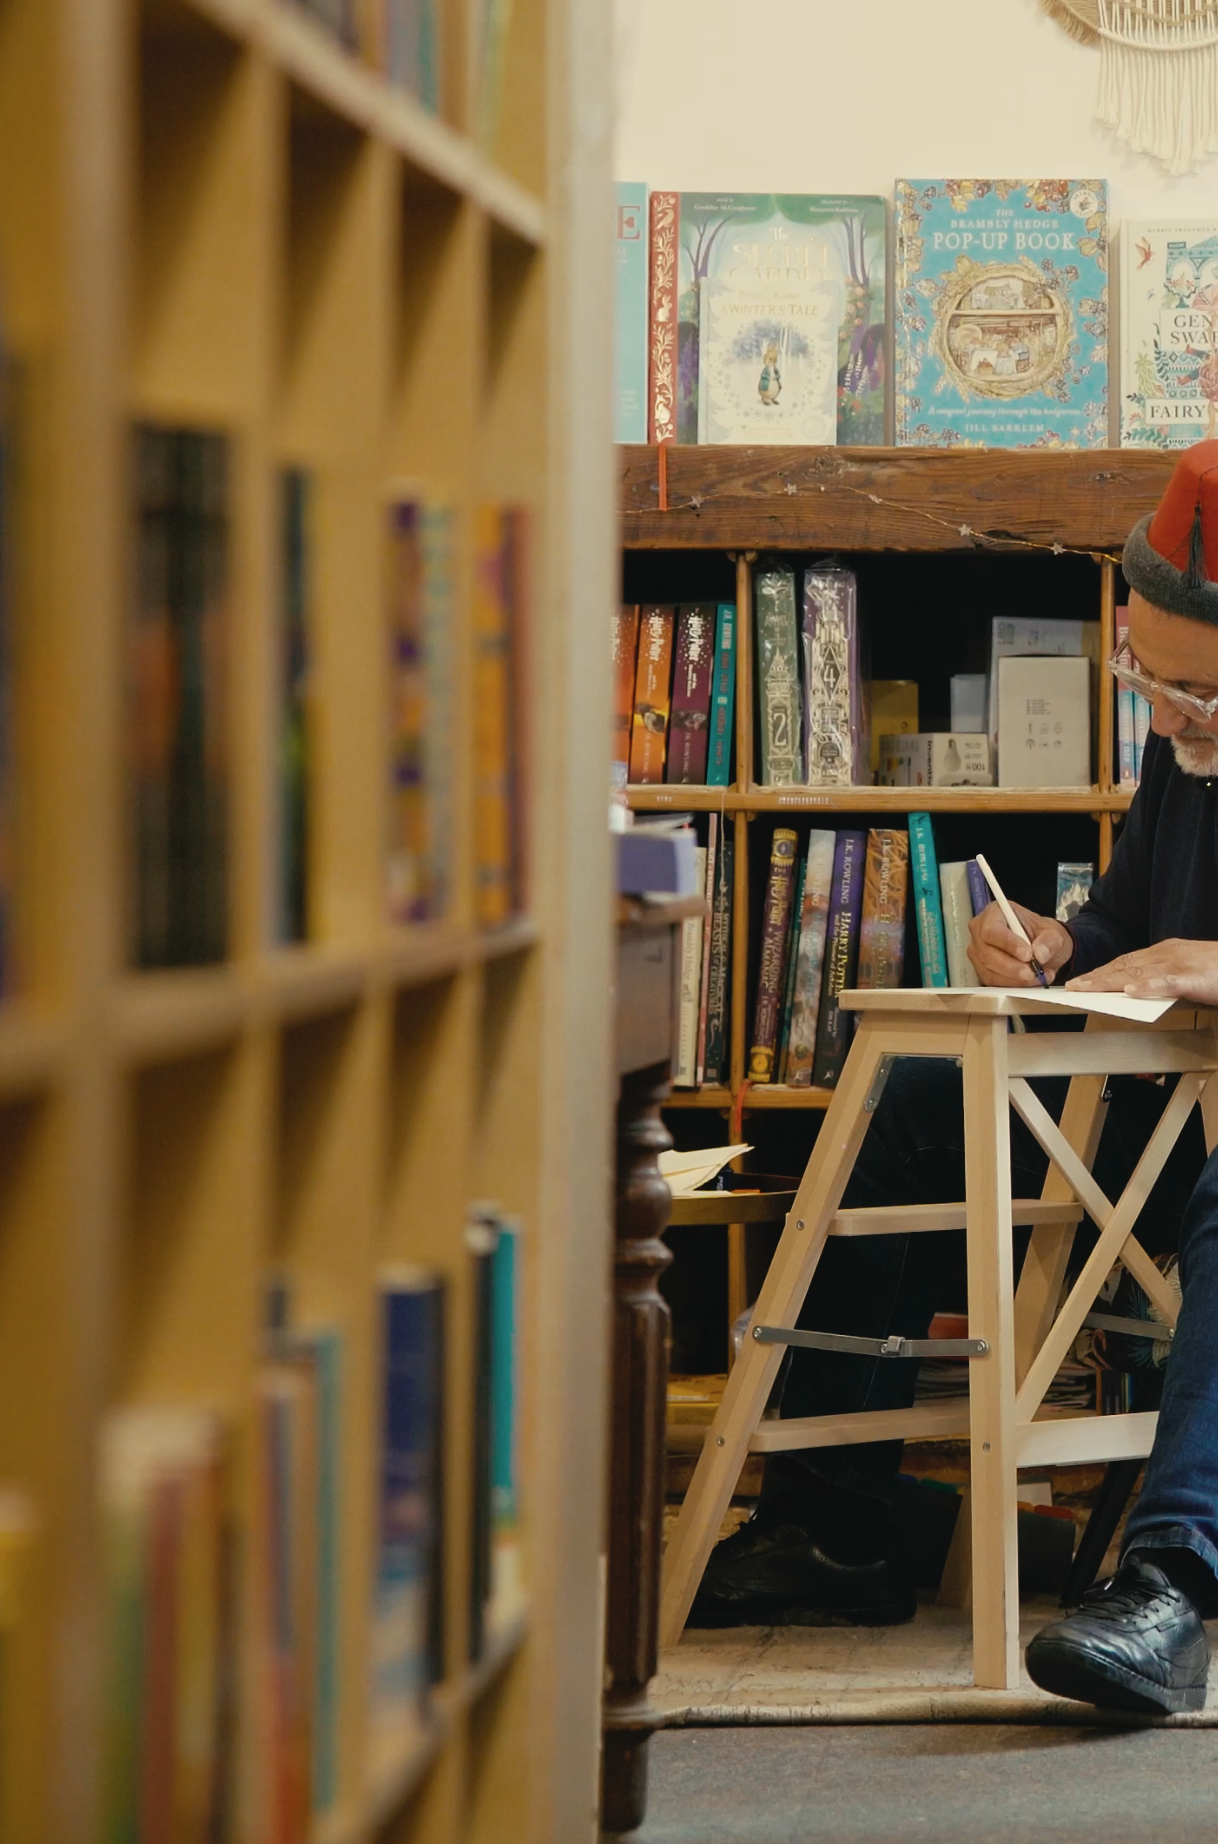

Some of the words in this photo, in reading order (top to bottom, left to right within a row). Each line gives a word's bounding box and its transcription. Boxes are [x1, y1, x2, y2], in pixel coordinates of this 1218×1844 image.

[933, 232, 1008, 250] POP-UP
[1015, 232, 1076, 250] BOOK
[951, 219, 1010, 229] BRAMBLY
[1014, 219, 1059, 229] HEDGE
[1150, 405, 1206, 418] FAIRY
[823, 665, 836, 688] 4
[773, 712, 787, 746] 2
[844, 838, 854, 855] J.K.
[840, 856, 852, 904] ROWLING
[879, 857, 890, 904] ROWLING
[712, 912, 722, 954] BEASTS
[838, 912, 852, 952] HARRY
[760, 936, 772, 989] ALMANAC
[768, 931, 784, 994] WIZARDING
